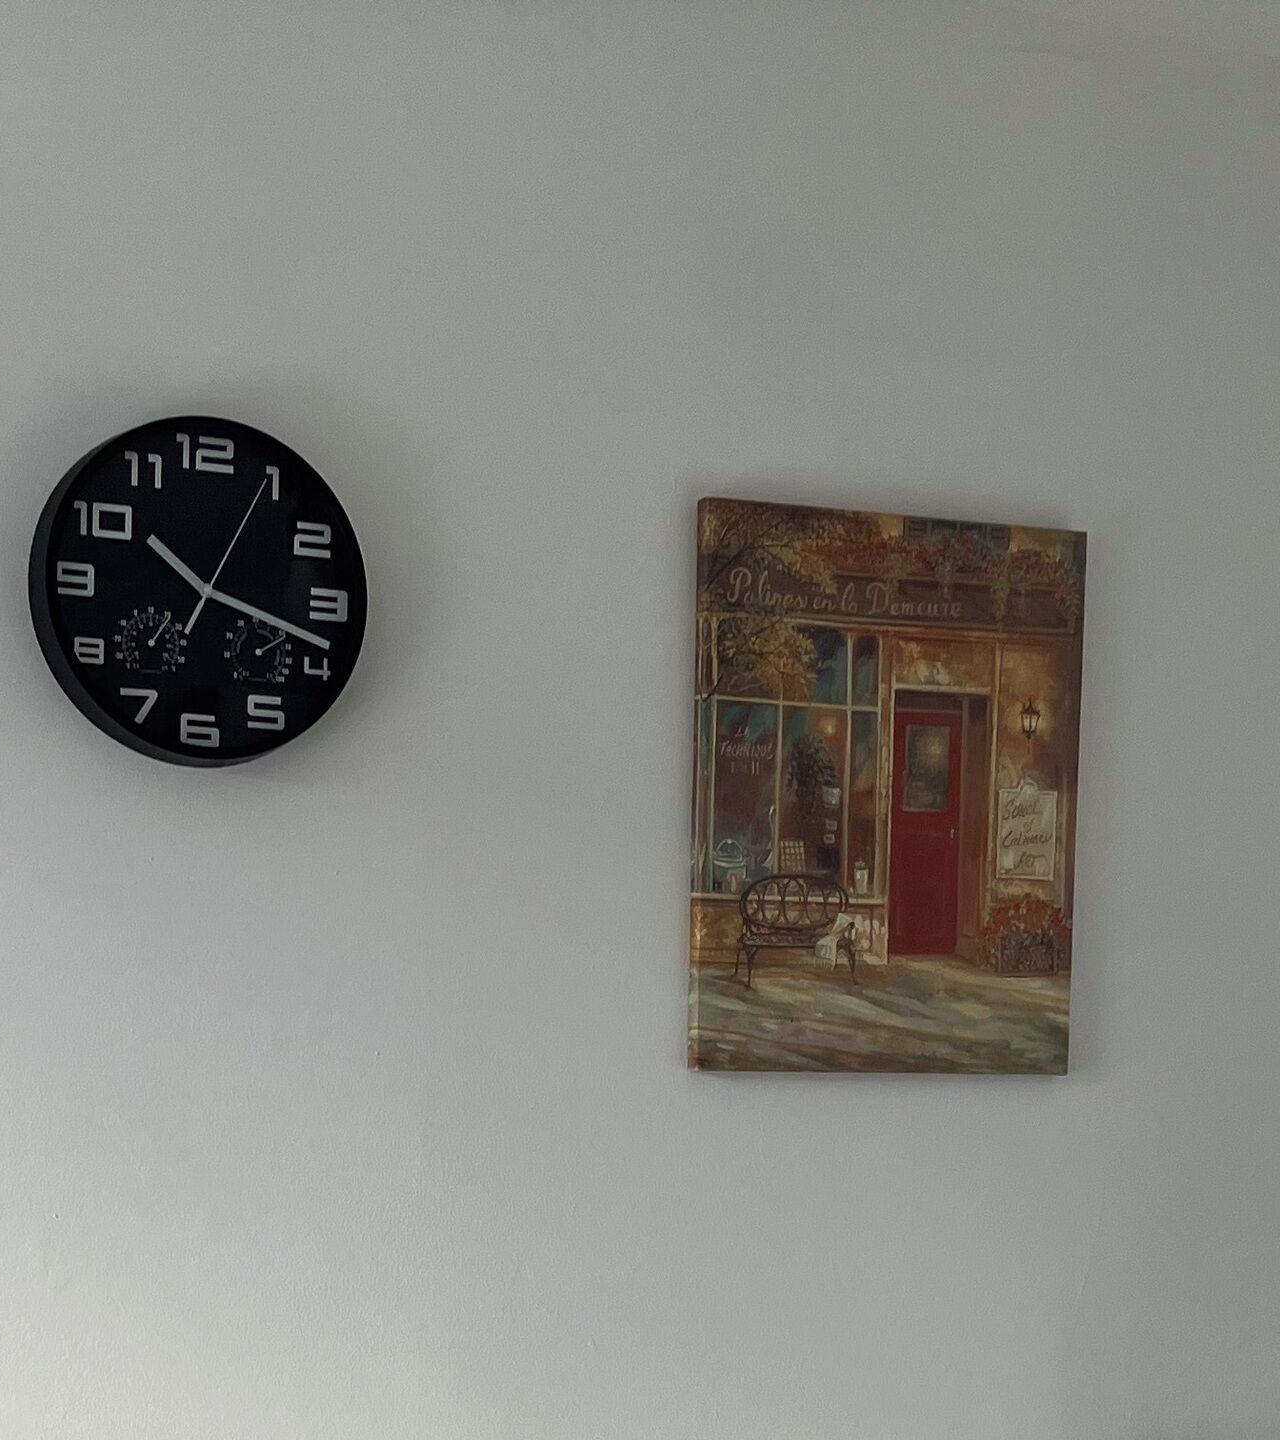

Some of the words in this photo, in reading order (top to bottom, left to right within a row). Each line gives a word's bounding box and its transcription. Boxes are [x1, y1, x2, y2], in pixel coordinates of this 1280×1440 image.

[124, 450, 163, 490] 11
[175, 432, 235, 475] 12
[265, 464, 281, 501] 1
[73, 500, 133, 541] 10
[292, 520, 332, 559] 2
[56, 560, 96, 598] 9
[308, 586, 349, 623] 3
[73, 636, 106, 666] 8
[303, 655, 332, 682] 4
[119, 686, 159, 725] 7
[246, 693, 286, 731] 5
[179, 712, 221, 748] 6
